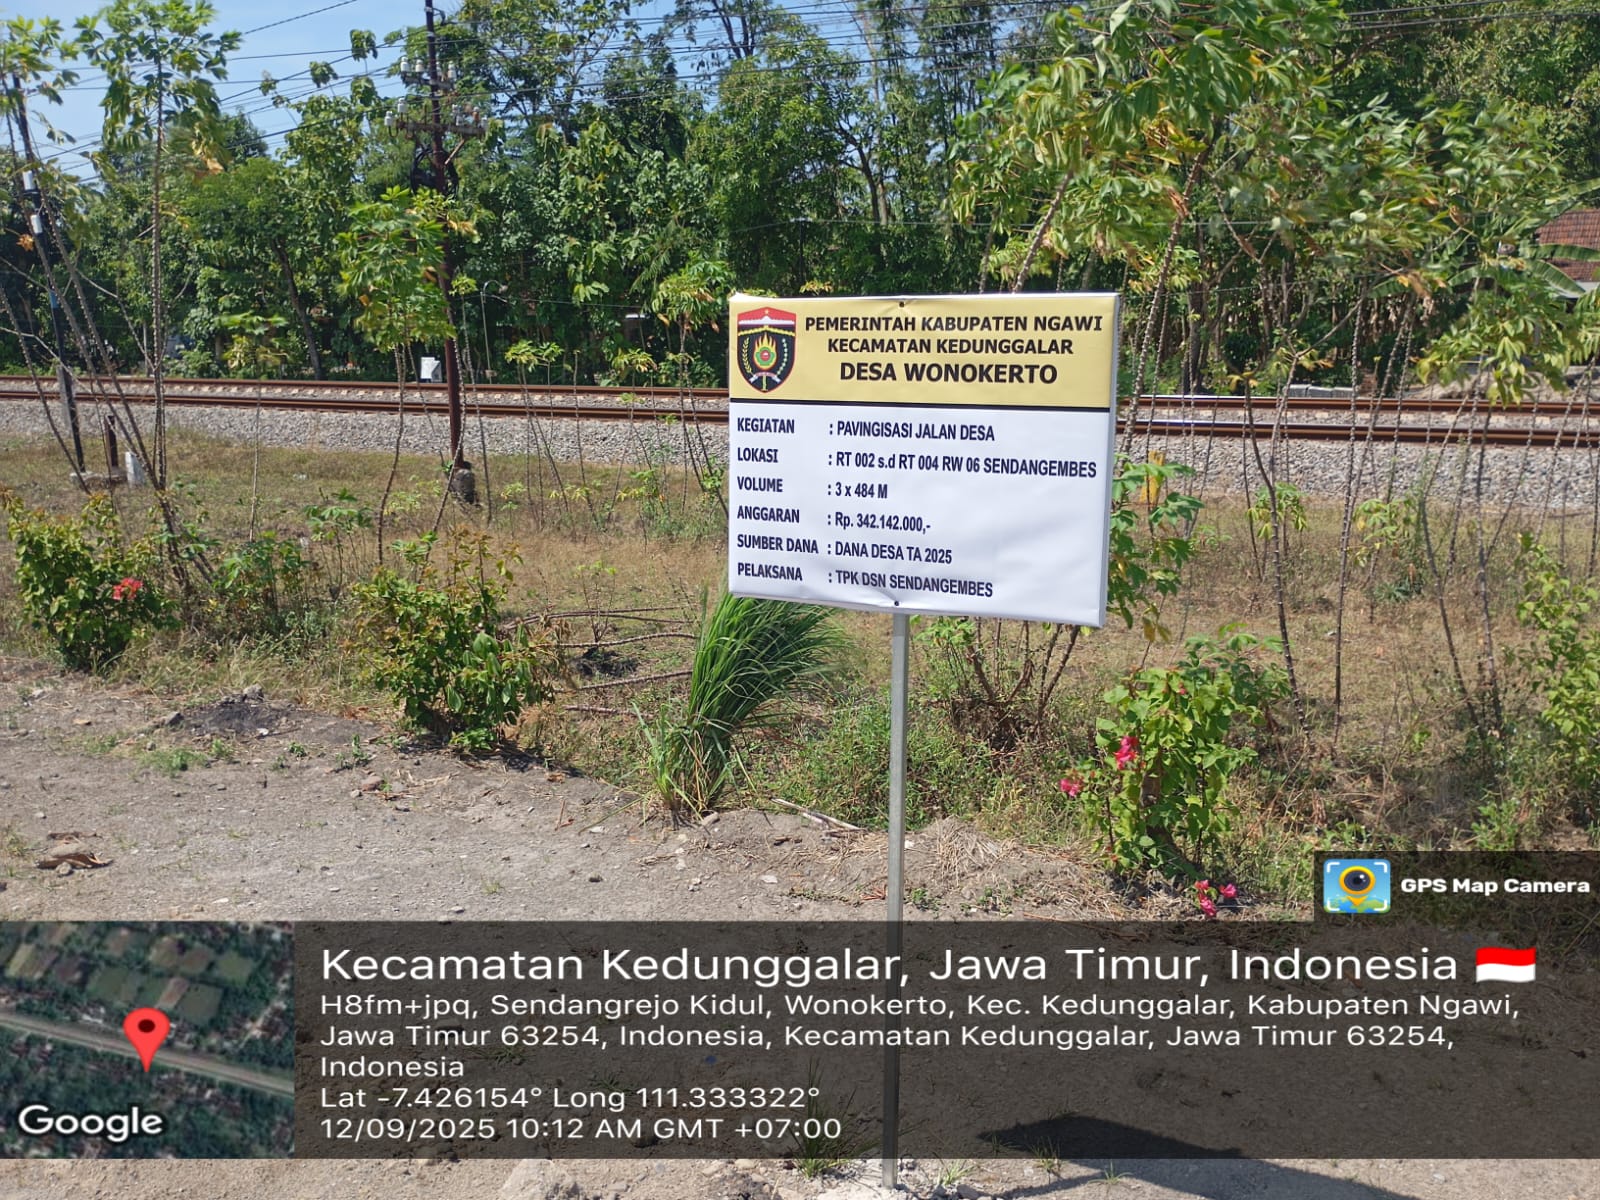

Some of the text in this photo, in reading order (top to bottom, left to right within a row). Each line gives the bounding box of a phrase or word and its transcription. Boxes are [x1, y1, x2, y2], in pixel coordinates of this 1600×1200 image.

[806, 316, 1102, 331] PEMERINTAH KABUPATEN NGAWI
[828, 338, 1073, 354] KECAMATAN KEDUNGGALAR
[841, 362, 1057, 384] DESA WONOKERTO
[738, 418, 794, 433] KEGIATAN
[838, 421, 912, 438] PAVINGISASI
[915, 424, 956, 439] JALAN
[960, 425, 994, 441] DESA
[738, 448, 778, 463] LOKASI
[837, 452, 852, 466] RT
[855, 453, 875, 467] 002
[878, 454, 895, 468] s.d
[899, 454, 915, 469] RT
[918, 455, 938, 470] 004
[943, 456, 963, 471] RW
[966, 457, 980, 472] 06
[984, 458, 1096, 478] SENDANGEMBES
[737, 476, 782, 492] VOLUME
[836, 482, 841, 496] 3
[845, 486, 851, 496] x
[855, 483, 874, 497] 484
[878, 484, 887, 498] M
[737, 506, 799, 523] ANGGARAN
[835, 512, 853, 530] Rp.
[857, 513, 930, 534] 342.142.000,-
[737, 534, 783, 551] SUMBER
[787, 538, 819, 553] DANA
[836, 541, 868, 557] DANA
[872, 544, 904, 560] DESA
[907, 546, 922, 561] TA
[925, 548, 952, 564] 2025
[738, 563, 802, 581] PELAKSANA
[835, 570, 859, 585] TPK
[862, 572, 886, 588] DSN
[890, 574, 992, 597] SENDANGEMBES
